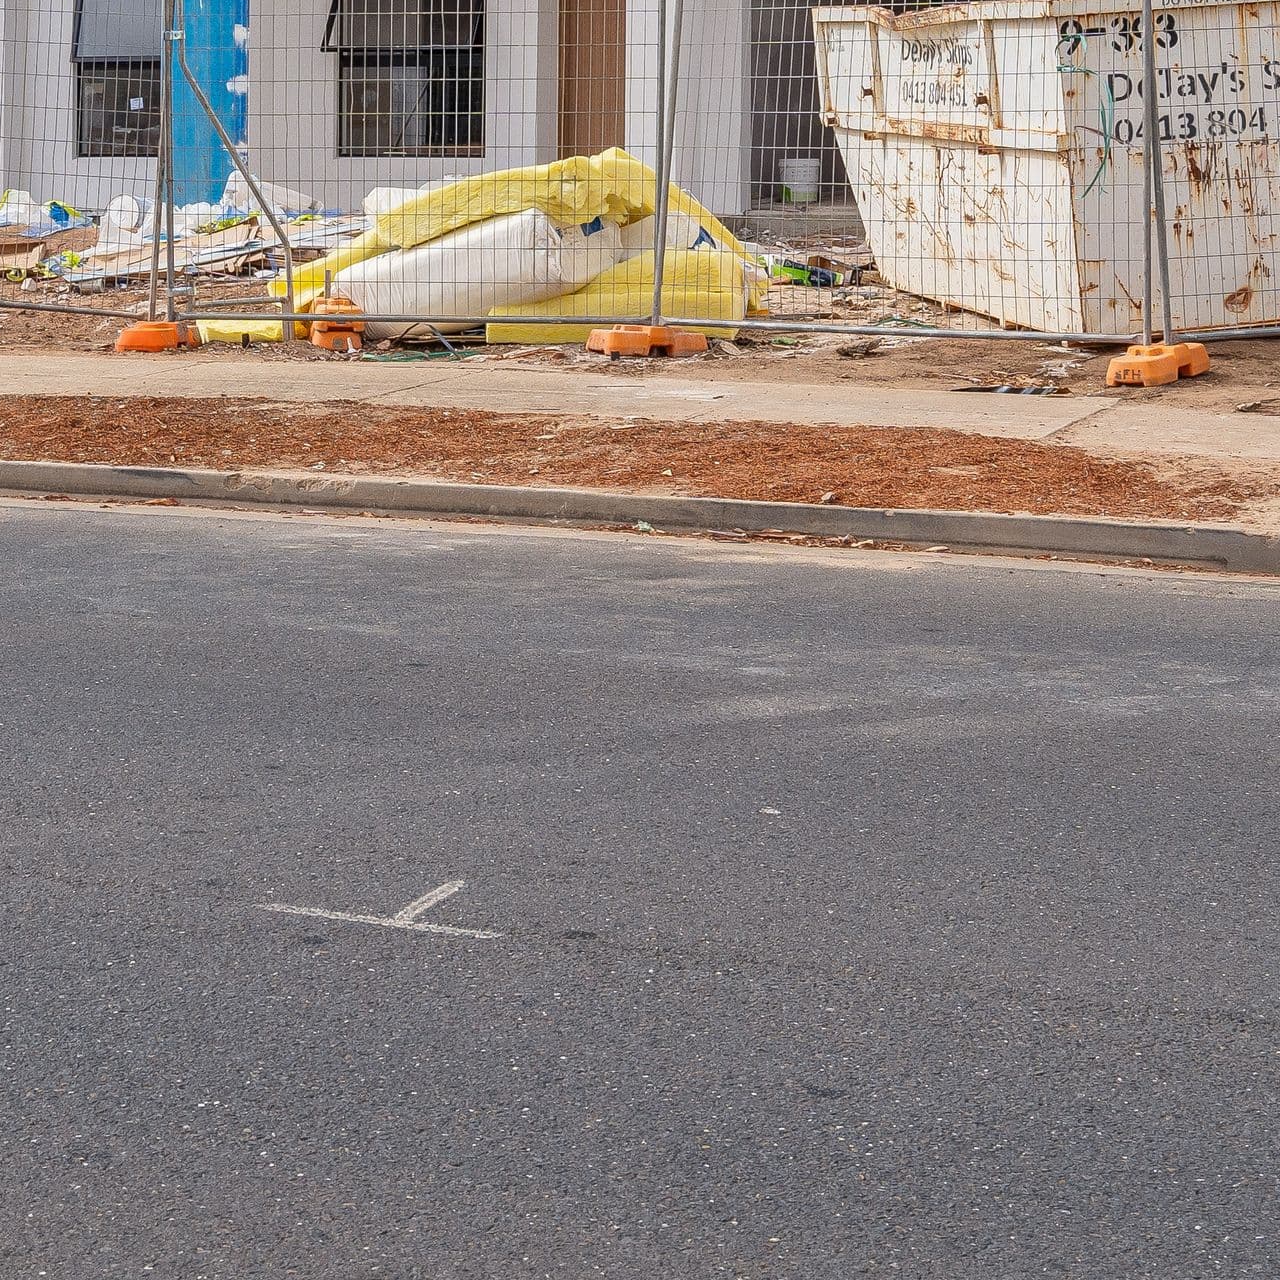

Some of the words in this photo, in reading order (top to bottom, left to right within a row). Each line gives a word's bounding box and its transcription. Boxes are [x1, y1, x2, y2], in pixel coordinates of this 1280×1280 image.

[944, 36, 973, 66] Skips
[902, 80, 926, 104] 0413
[1207, 106, 1267, 137] 804
